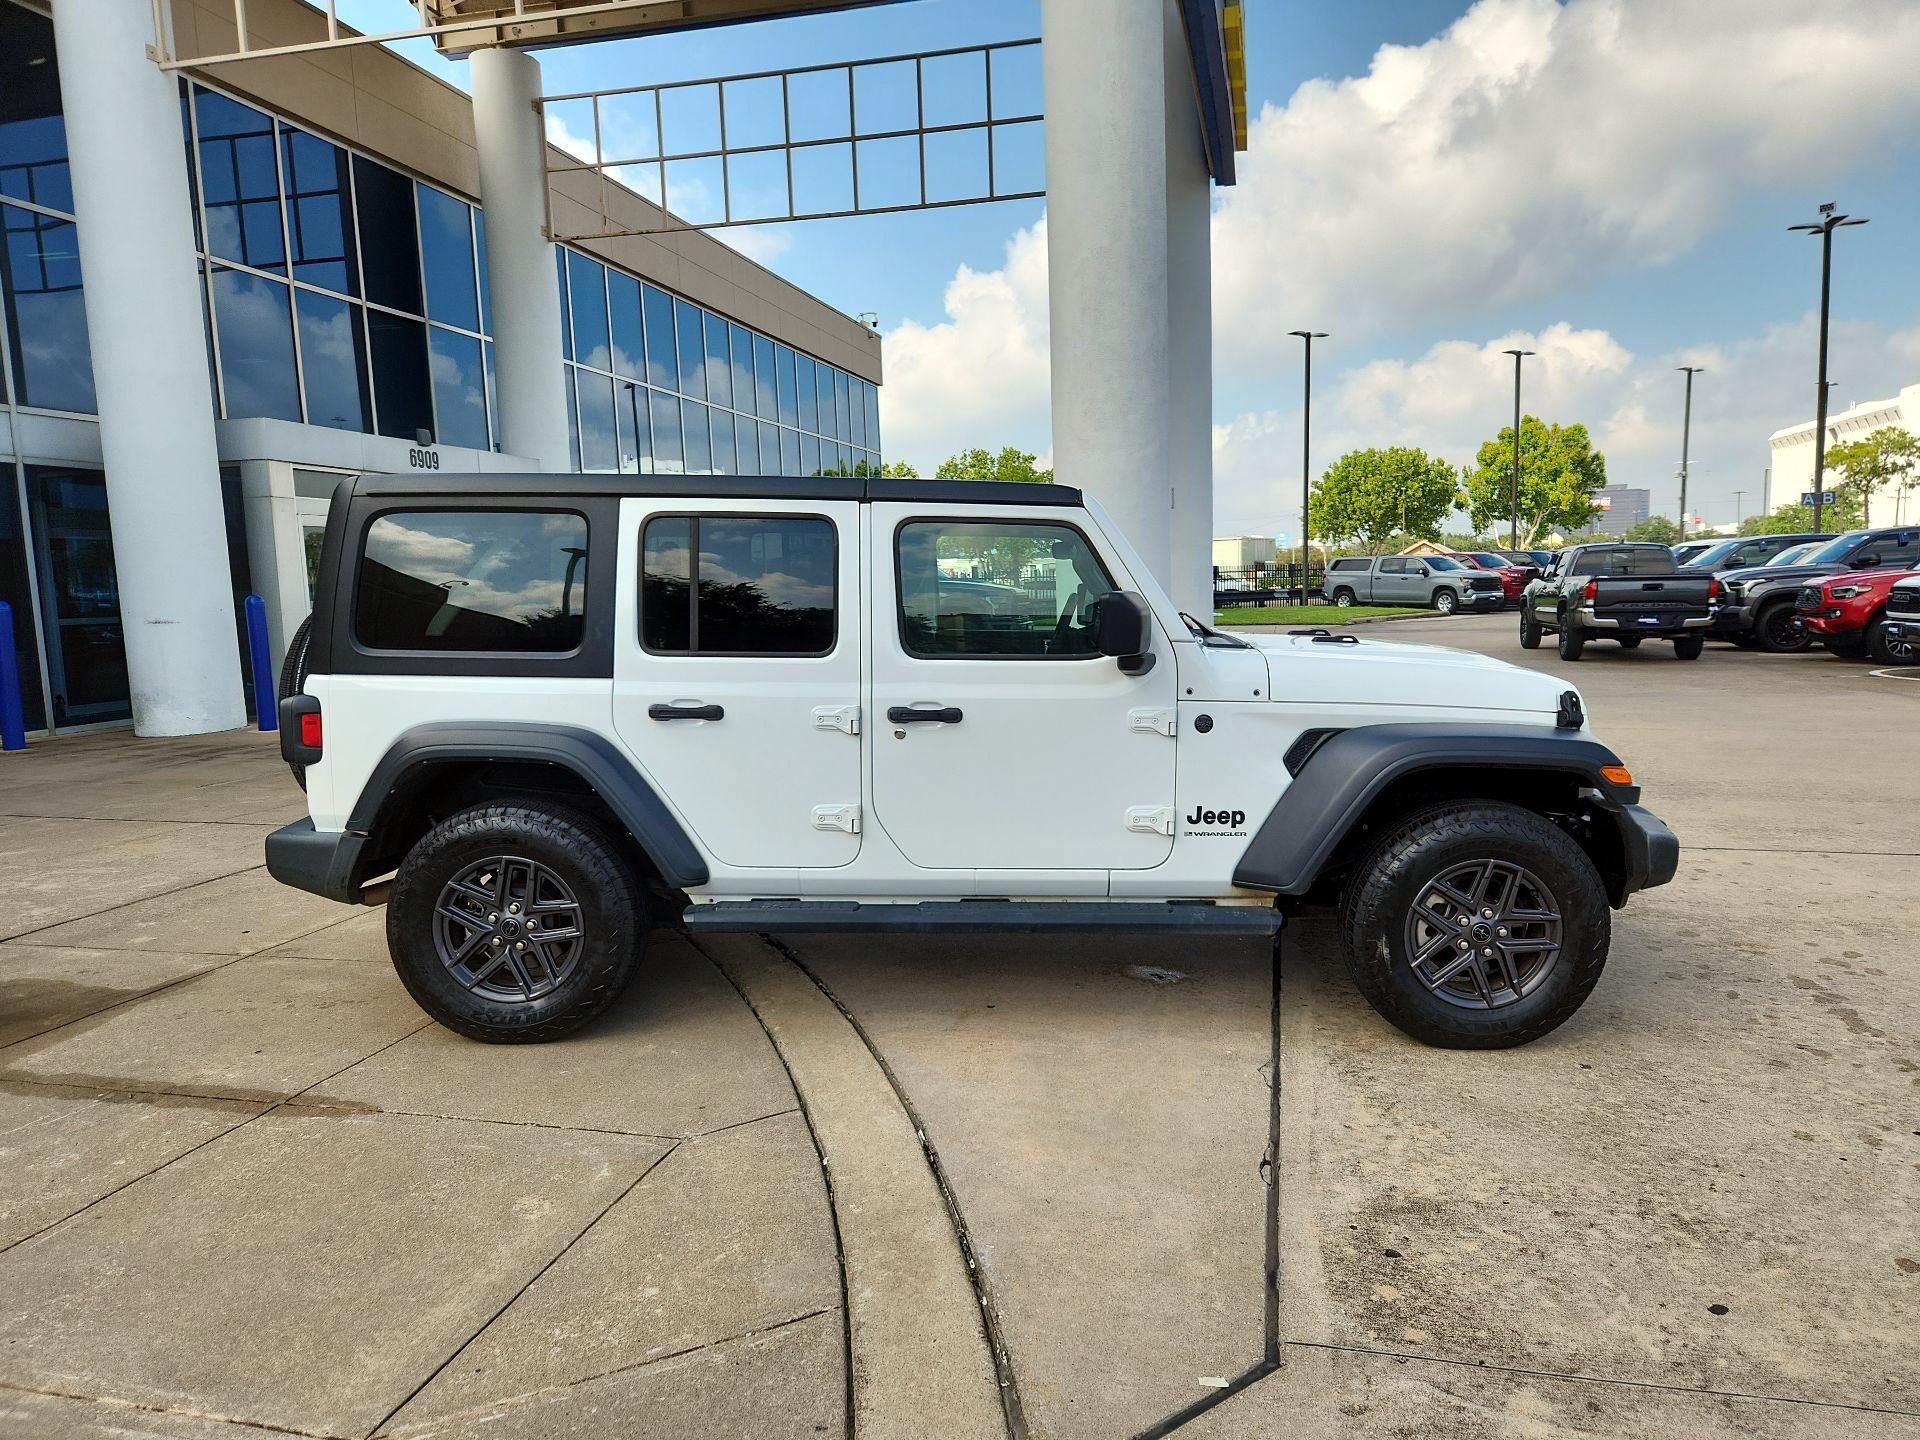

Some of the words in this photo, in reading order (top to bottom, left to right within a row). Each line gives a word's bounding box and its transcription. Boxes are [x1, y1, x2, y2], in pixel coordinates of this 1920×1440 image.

[410, 448, 439, 470] 6909
[1803, 494, 1815, 505] A
[1823, 492, 1834, 504] B
[1186, 805, 1246, 829] Jeep
